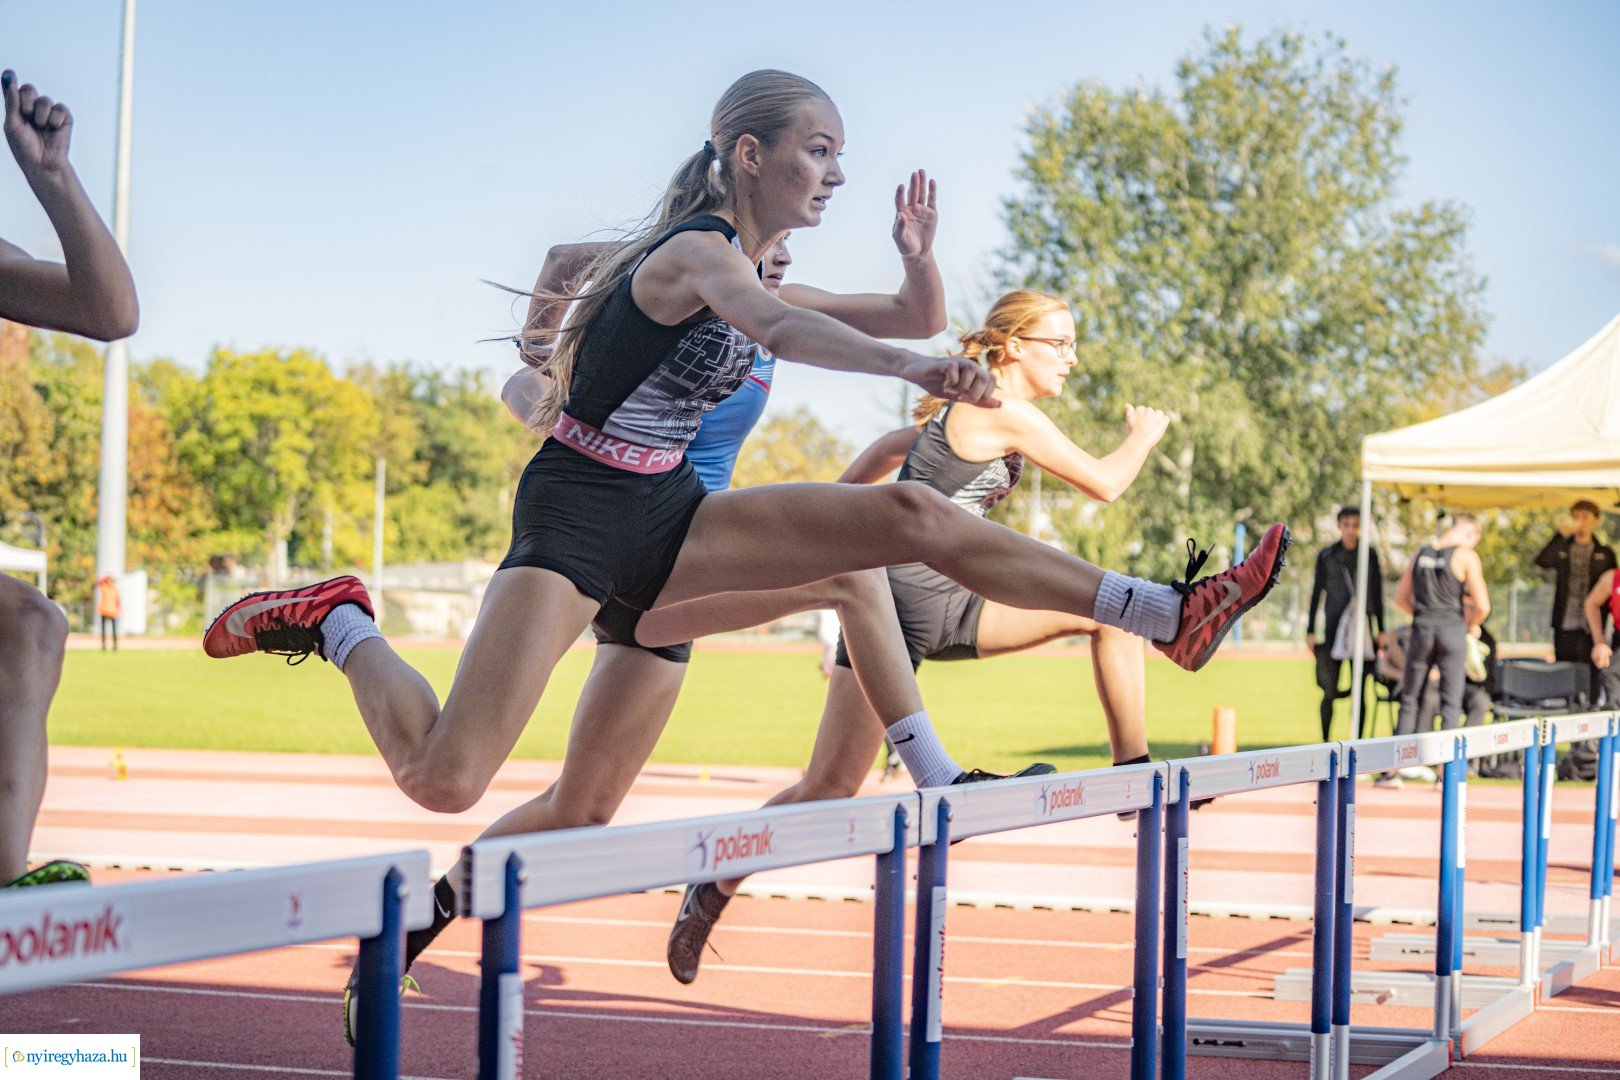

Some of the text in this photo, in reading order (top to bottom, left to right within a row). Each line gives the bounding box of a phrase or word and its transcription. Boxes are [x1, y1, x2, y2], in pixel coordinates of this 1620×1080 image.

[566, 424, 647, 466] NIKE
[1256, 757, 1280, 785] polanik
[1050, 781, 1084, 816] polanik
[713, 823, 774, 871] polanik
